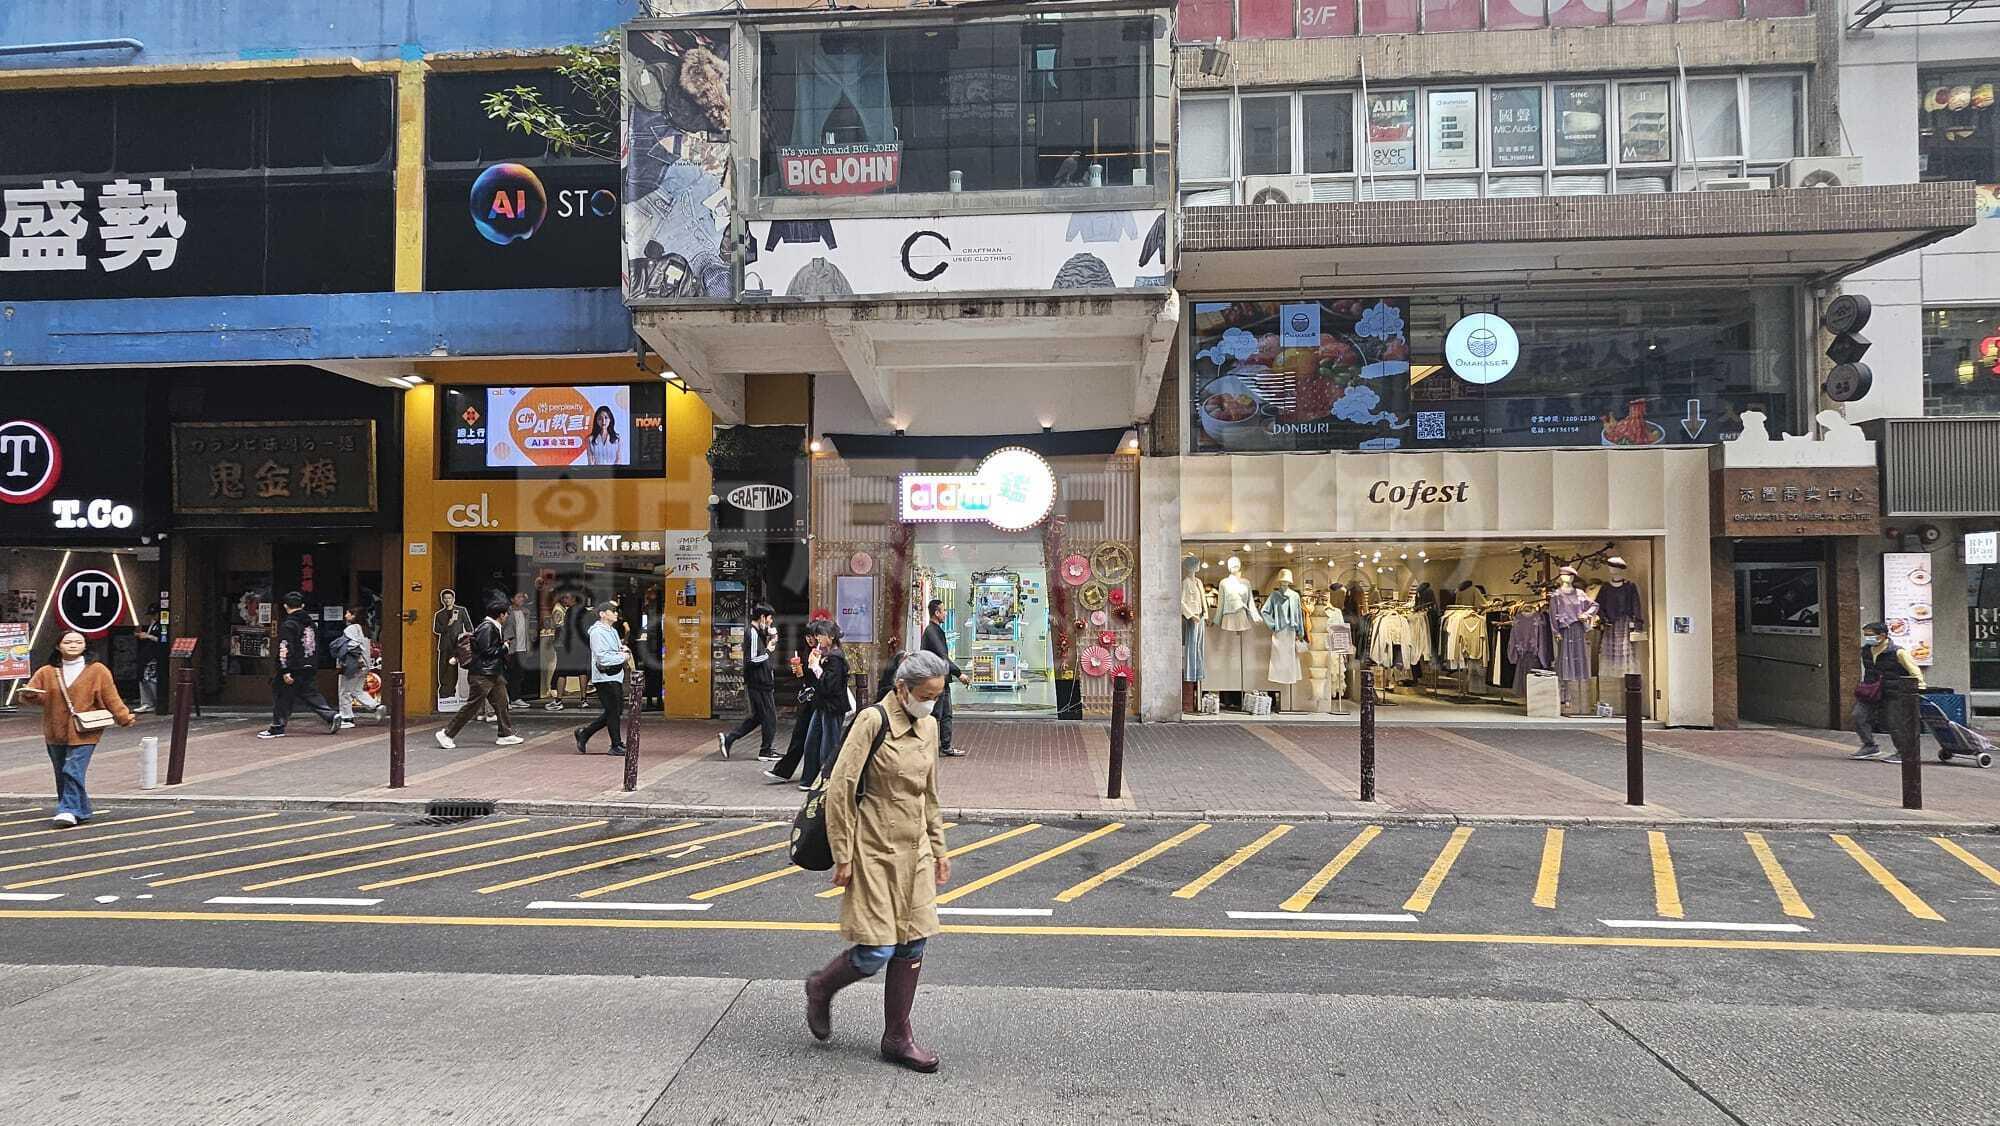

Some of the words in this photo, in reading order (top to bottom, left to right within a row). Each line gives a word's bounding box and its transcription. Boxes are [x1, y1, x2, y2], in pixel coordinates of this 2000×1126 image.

[1302, 6, 1337, 26] 3/F
[1372, 99, 1409, 112] AIM
[782, 147, 796, 157] It's
[798, 148, 819, 158] your
[822, 145, 850, 155] brand
[852, 144, 869, 153] BIG
[873, 143, 899, 153] JOHN
[787, 158, 827, 185] BIG
[830, 156, 892, 184] JOHN
[487, 190, 526, 220] AI
[0, 177, 187, 272] 盛勢
[548, 402, 584, 413] perplexity
[1273, 422, 1329, 434] DONBURI
[0, 434, 37, 477] T
[208, 457, 338, 499] 鬼金棒
[731, 486, 789, 509] CRAFTMAN
[1369, 479, 1469, 510] Cofest
[52, 499, 133, 529] T.Co
[582, 534, 622, 552] HKT
[677, 563, 691, 572] 1/F
[76, 581, 110, 617] T
